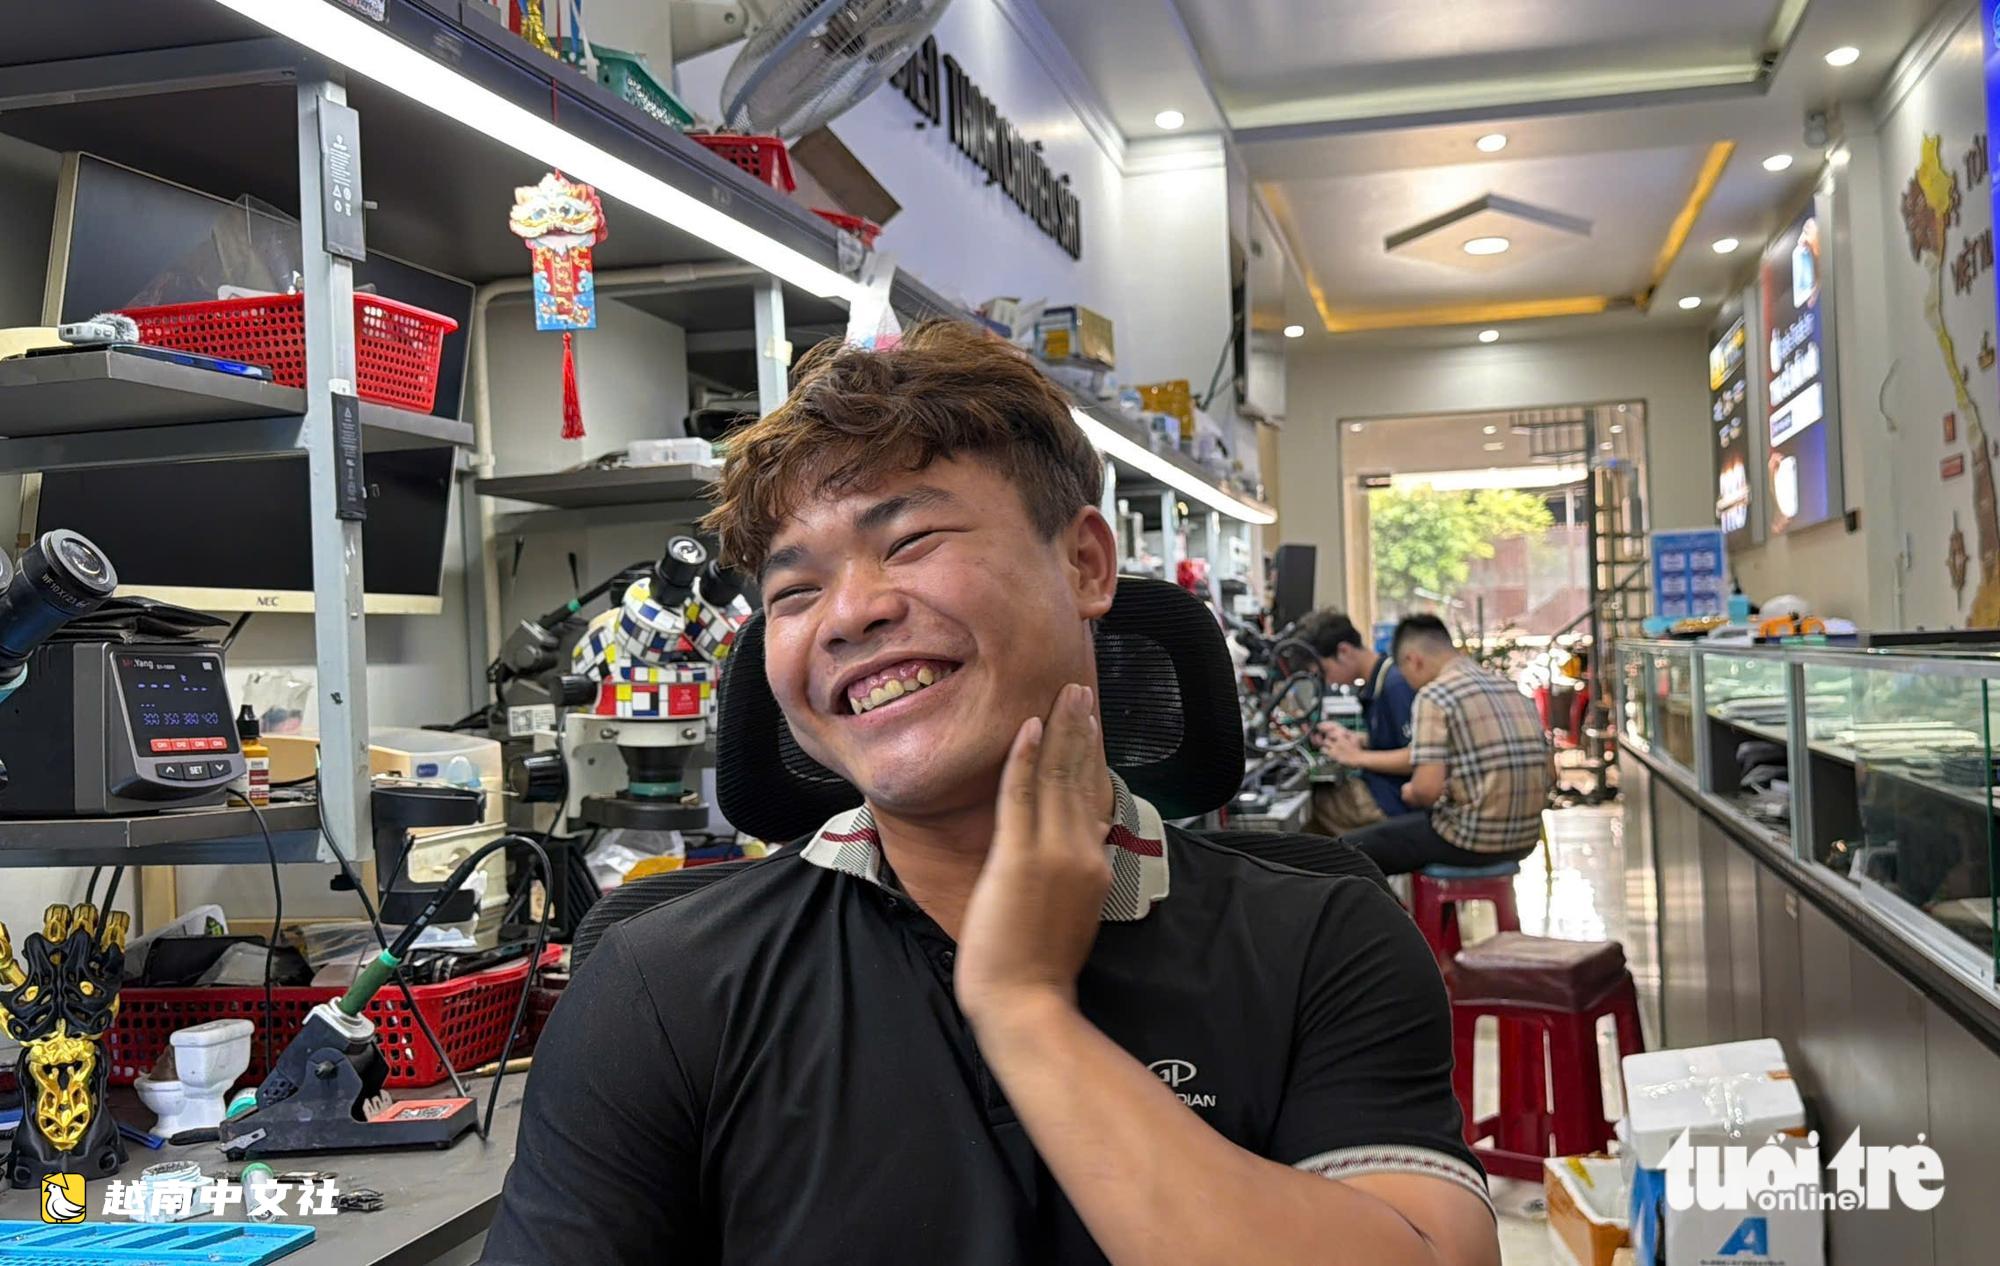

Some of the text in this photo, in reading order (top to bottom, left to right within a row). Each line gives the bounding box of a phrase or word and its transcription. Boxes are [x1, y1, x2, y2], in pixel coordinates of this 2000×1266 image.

[255, 596, 280, 607] NEC
[189, 765, 204, 775] SET
[1174, 1093, 1217, 1107] DIAN
[1716, 1216, 1769, 1256] A
